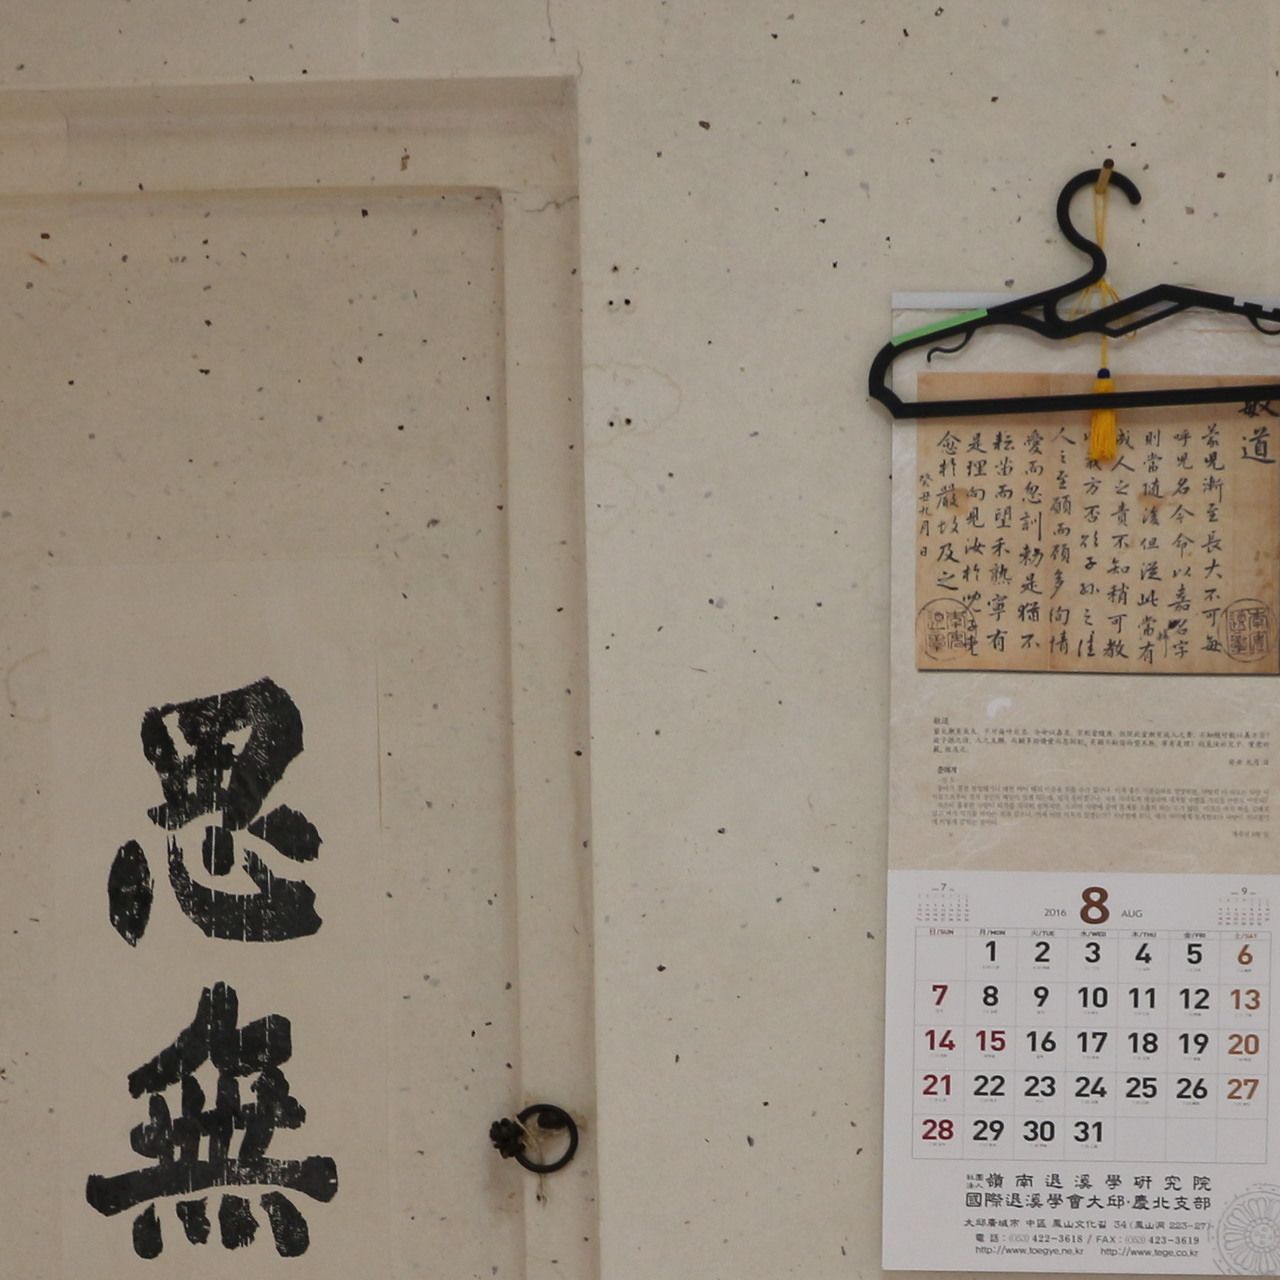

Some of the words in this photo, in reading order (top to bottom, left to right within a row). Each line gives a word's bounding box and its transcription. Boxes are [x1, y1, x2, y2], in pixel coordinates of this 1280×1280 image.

[1080, 887, 1109, 924] 8
[1121, 910, 1143, 918] AUG
[985, 940, 996, 962] 1
[1034, 941, 1050, 963] 2
[1085, 941, 1101, 964] 3
[1135, 942, 1152, 964] 4
[1187, 943, 1203, 965] 5
[1237, 944, 1253, 966] 6
[932, 984, 948, 1006] 7
[982, 985, 999, 1007] 8
[1033, 986, 1049, 1008] 9
[1078, 986, 1108, 1008] 10
[1128, 987, 1155, 1009] 11
[1179, 988, 1210, 1010] 12
[1230, 988, 1261, 1011] 13
[925, 1029, 956, 1051] 14
[975, 1030, 1006, 1052] 15
[1026, 1030, 1057, 1053] 16
[1077, 1031, 1108, 1053] 17
[1128, 1032, 1159, 1054] 18
[1178, 1033, 1209, 1055] 19
[1227, 1033, 1260, 1055] 20
[922, 1074, 951, 1096] 21
[973, 1074, 1006, 1097] 22
[1024, 1075, 1056, 1097] 23
[1074, 1076, 1108, 1098] 24
[1125, 1076, 1158, 1099] 25
[1176, 1077, 1208, 1100] 26
[1226, 1078, 1260, 1100] 27
[921, 1118, 954, 1141] 28
[972, 1119, 1005, 1141] 29
[1023, 1120, 1055, 1142] 30
[1073, 1120, 1102, 1143] 31
